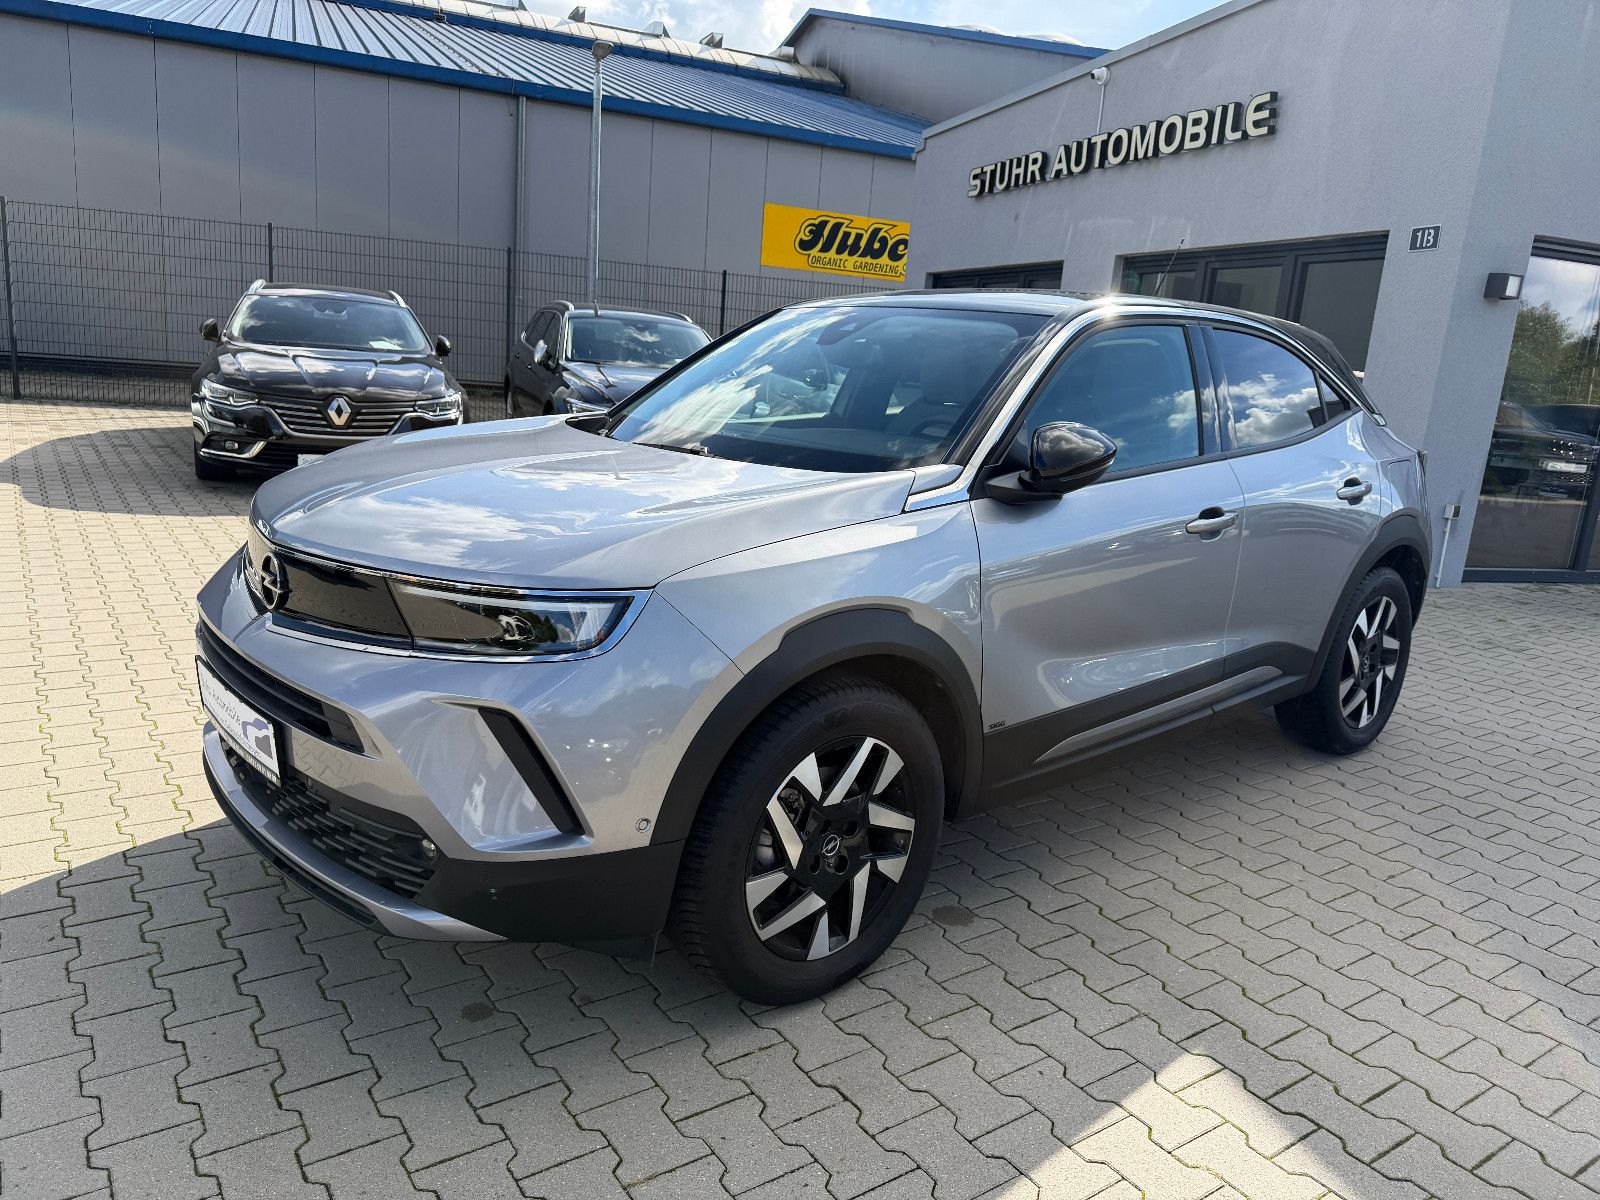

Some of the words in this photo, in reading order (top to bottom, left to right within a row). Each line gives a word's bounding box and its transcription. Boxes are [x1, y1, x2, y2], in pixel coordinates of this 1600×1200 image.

[968, 150, 1046, 198] STUHR
[1050, 91, 1277, 179] AUTOMOBILE
[810, 255, 848, 269] ORGANIC
[852, 260, 900, 275] GARDENING
